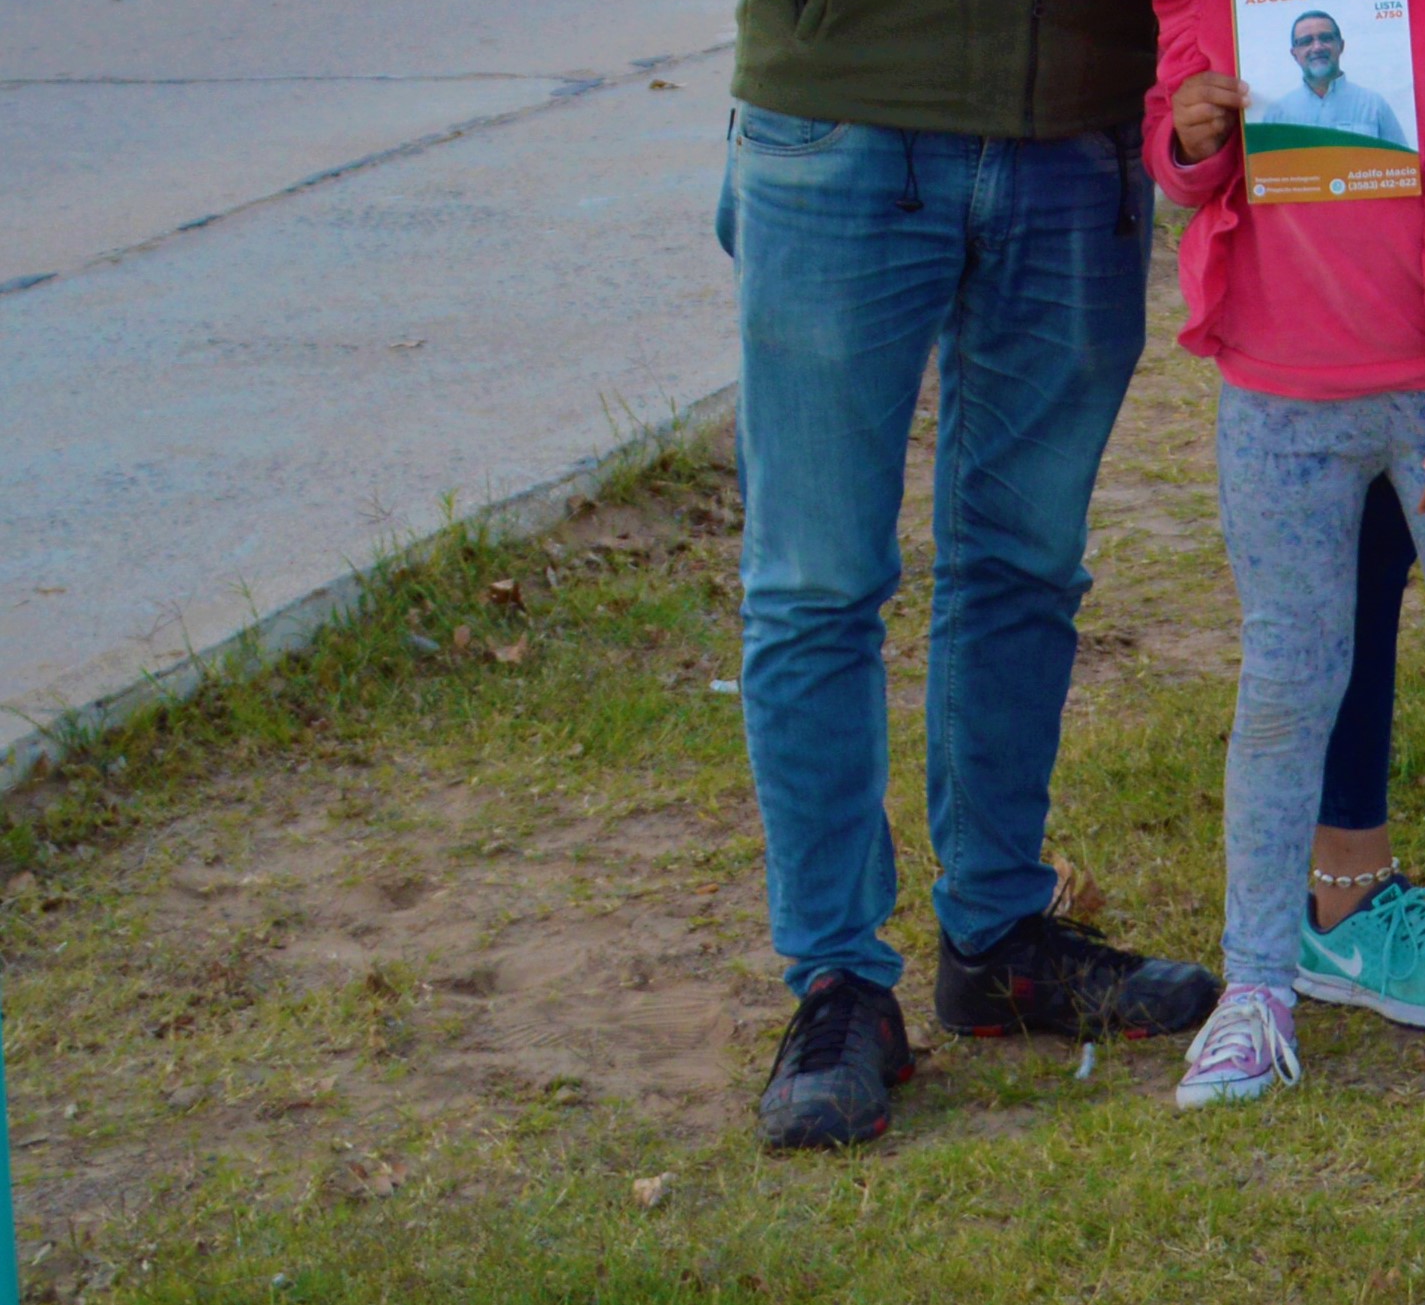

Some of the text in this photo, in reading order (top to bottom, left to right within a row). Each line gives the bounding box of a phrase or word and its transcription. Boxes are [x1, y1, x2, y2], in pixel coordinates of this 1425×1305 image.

[1374, 1, 1403, 11] LISTA
[1347, 167, 1417, 180] Adolfo Macio
